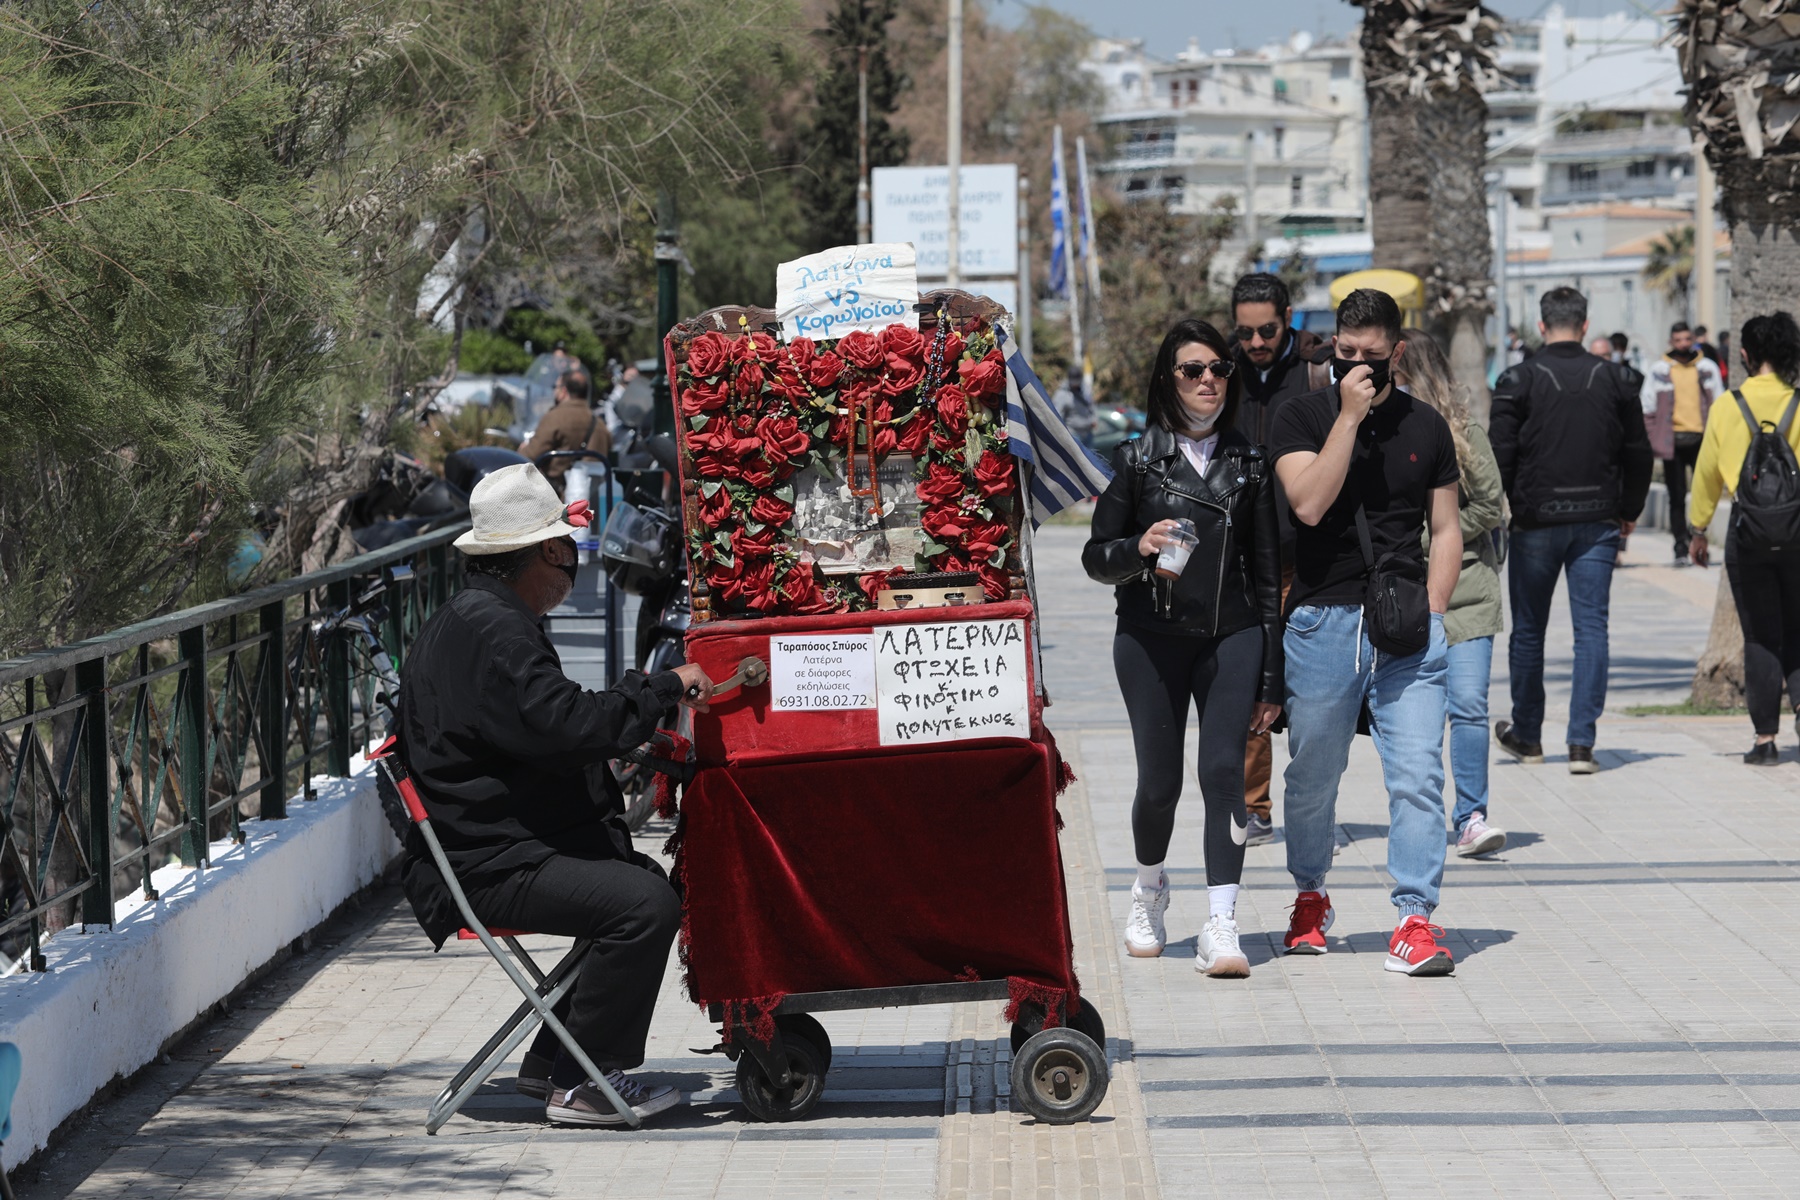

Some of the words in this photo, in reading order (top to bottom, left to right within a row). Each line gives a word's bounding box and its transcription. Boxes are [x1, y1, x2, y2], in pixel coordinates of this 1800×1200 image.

[880, 622, 1022, 655] ΛΑΤΕΡΝΑ
[777, 641, 831, 653] Ταραπόσος
[832, 640, 868, 653] Σπύρος
[803, 655, 842, 666] Λατέρνα
[808, 669, 852, 679] διάφορες
[796, 682, 850, 692] εκδηλώσεις
[779, 694, 867, 707] 6931.08.02.72
[894, 685, 999, 711] ΦΙΛΟΤΙΜΟ
